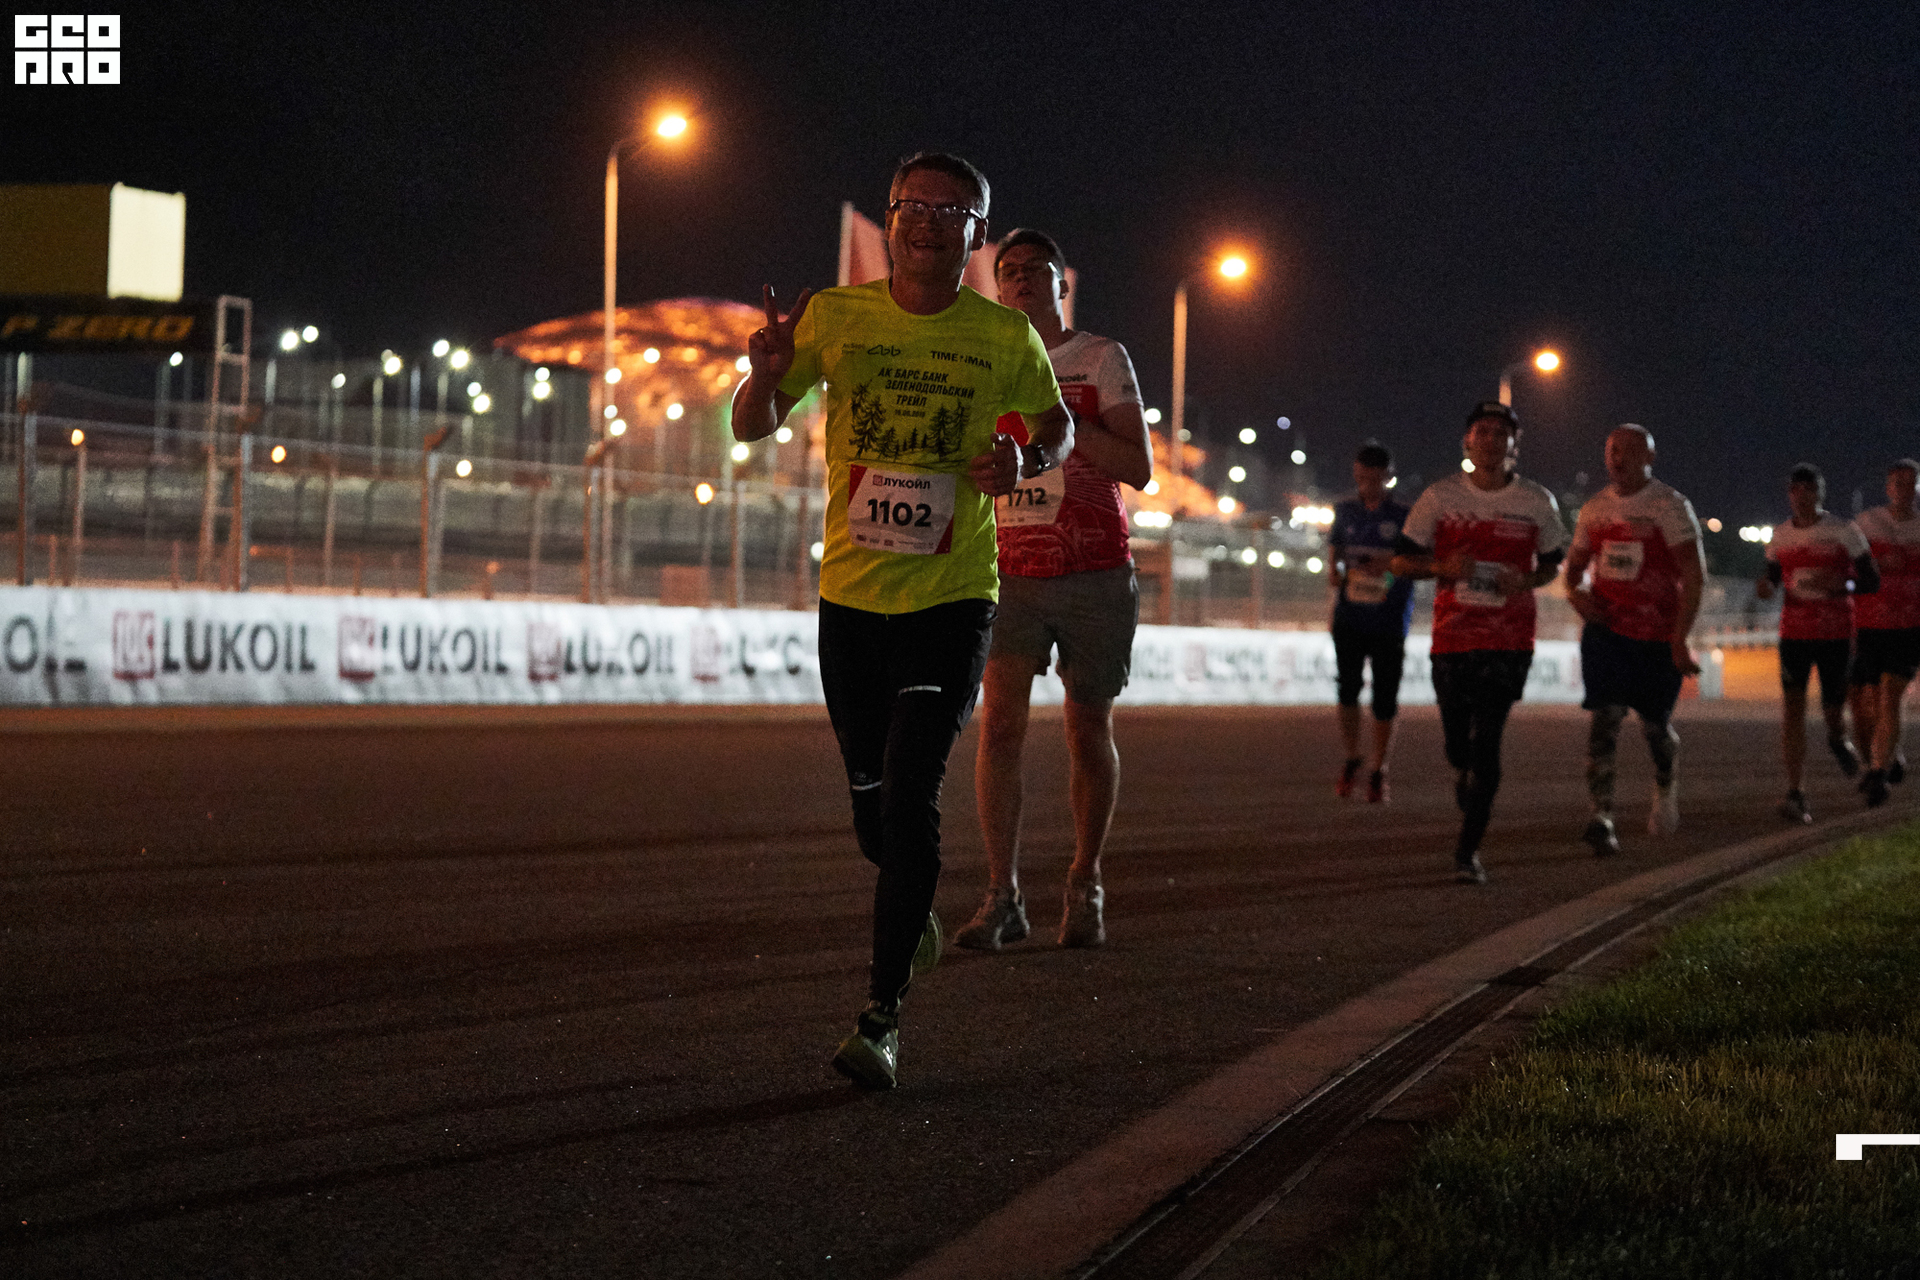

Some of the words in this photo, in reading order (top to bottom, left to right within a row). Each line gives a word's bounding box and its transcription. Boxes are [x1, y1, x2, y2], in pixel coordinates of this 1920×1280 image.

[47, 315, 194, 342] ZERO
[878, 367, 892, 377] АК
[894, 368, 920, 379] БАРС
[922, 371, 949, 383] БАНК
[885, 379, 975, 399] ЗЕЛЕНОДОЛЬСКИЙ
[896, 394, 927, 407] ТРЕЙЛ
[883, 477, 931, 490] ЛУКОЙЛ
[1007, 487, 1047, 507] 1712
[868, 498, 932, 528] 1102
[161, 615, 316, 675] LUKOIL
[380, 622, 508, 674] LUKOIL
